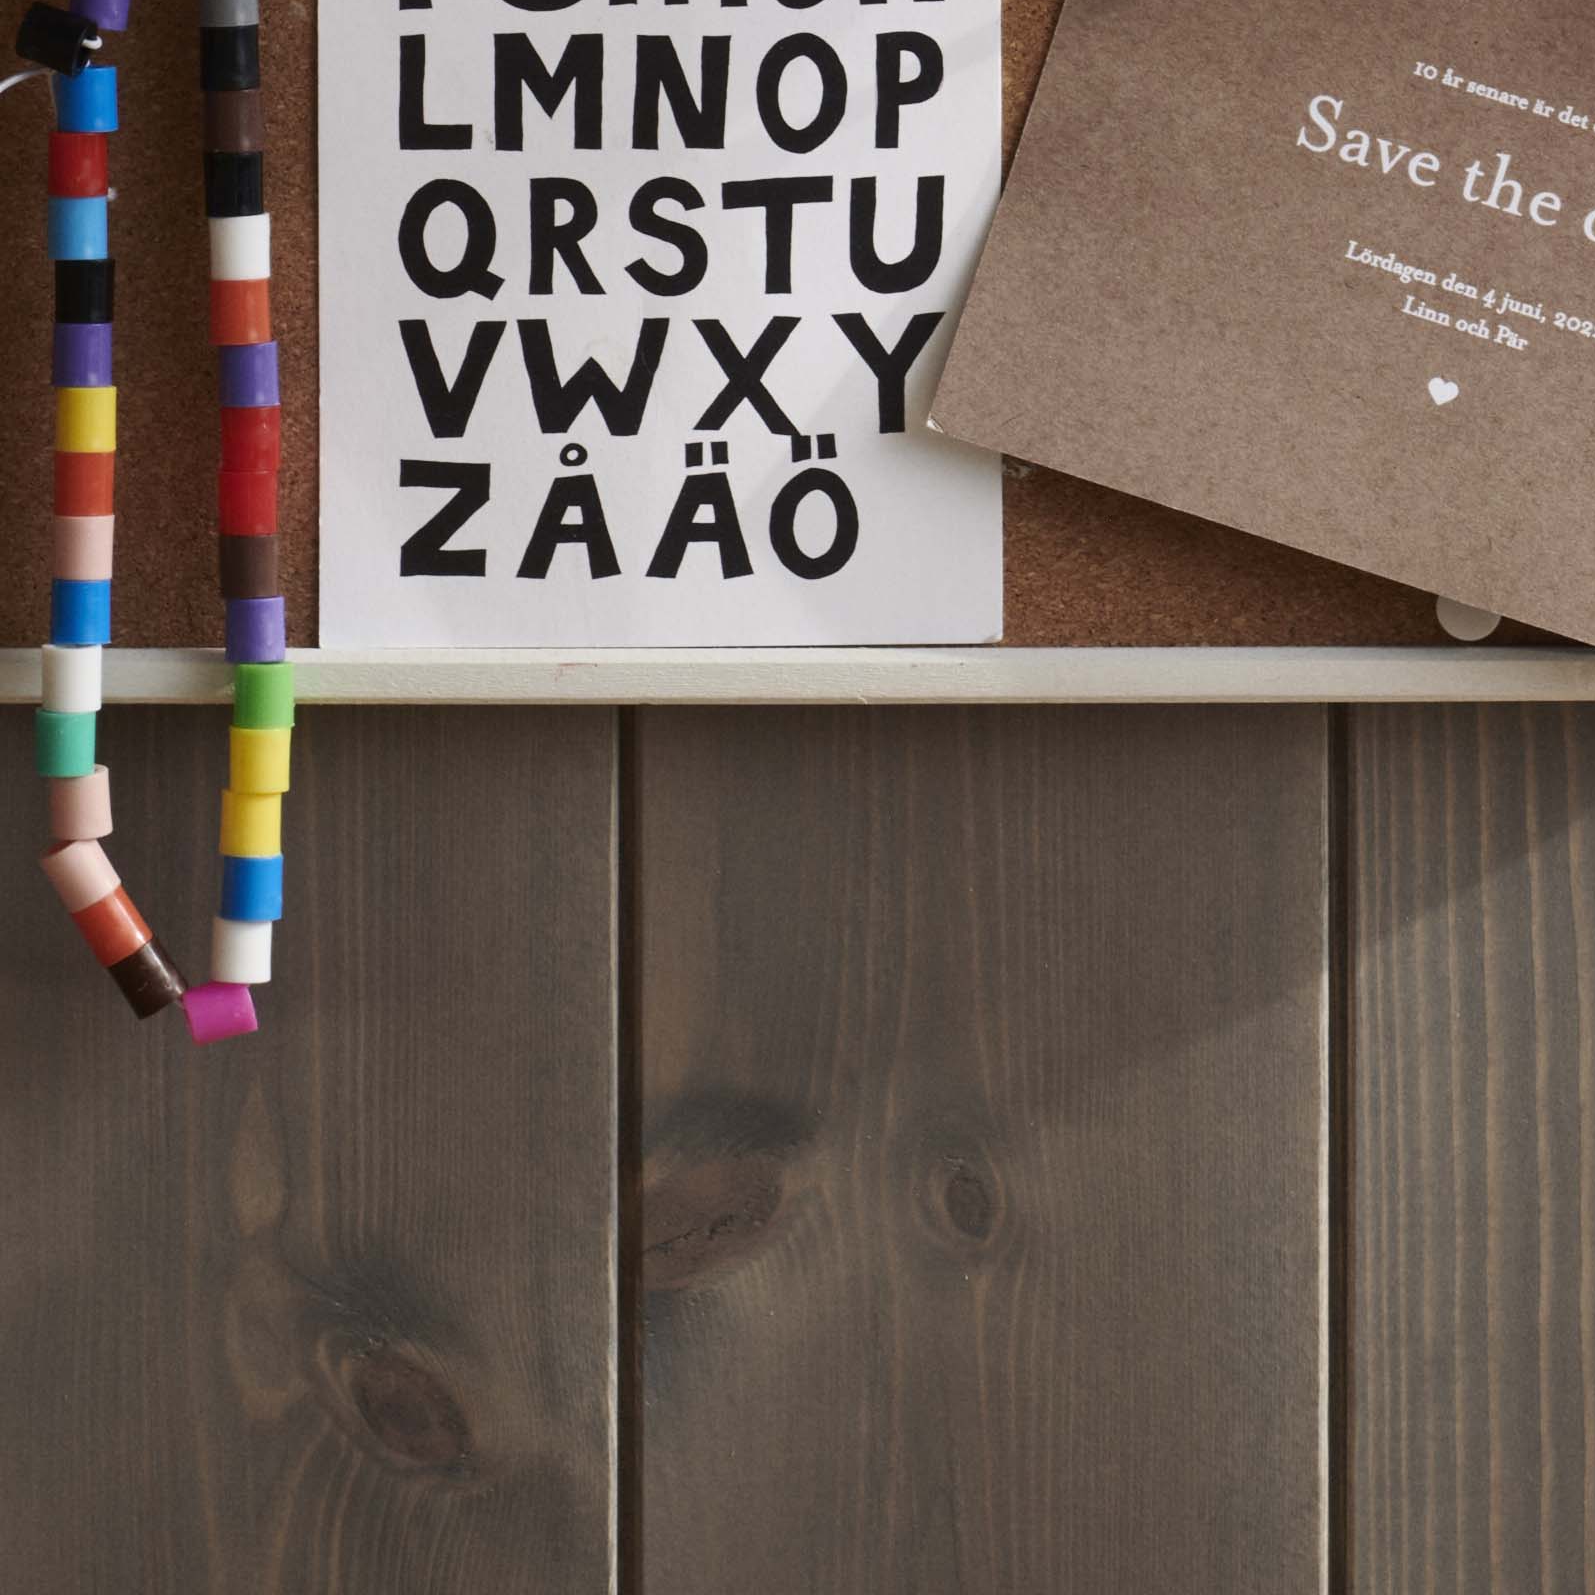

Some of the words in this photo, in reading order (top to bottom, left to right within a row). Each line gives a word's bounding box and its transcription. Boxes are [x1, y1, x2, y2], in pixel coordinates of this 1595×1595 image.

[1412, 61, 1438, 80] 10
[1442, 68, 1464, 89] år
[1466, 79, 1530, 111] senare
[1533, 98, 1555, 119] är
[1558, 105, 1588, 129] det
[1296, 94, 1441, 188] Save
[1461, 153, 1562, 227] the
[1345, 240, 1437, 286] Lördagen
[1442, 272, 1478, 300] den
[1482, 289, 1497, 309] 4
[1495, 291, 1548, 324] juni,
[1401, 295, 1451, 327] Linn
[1455, 316, 1490, 340] och
[1494, 323, 1530, 352] Pär
